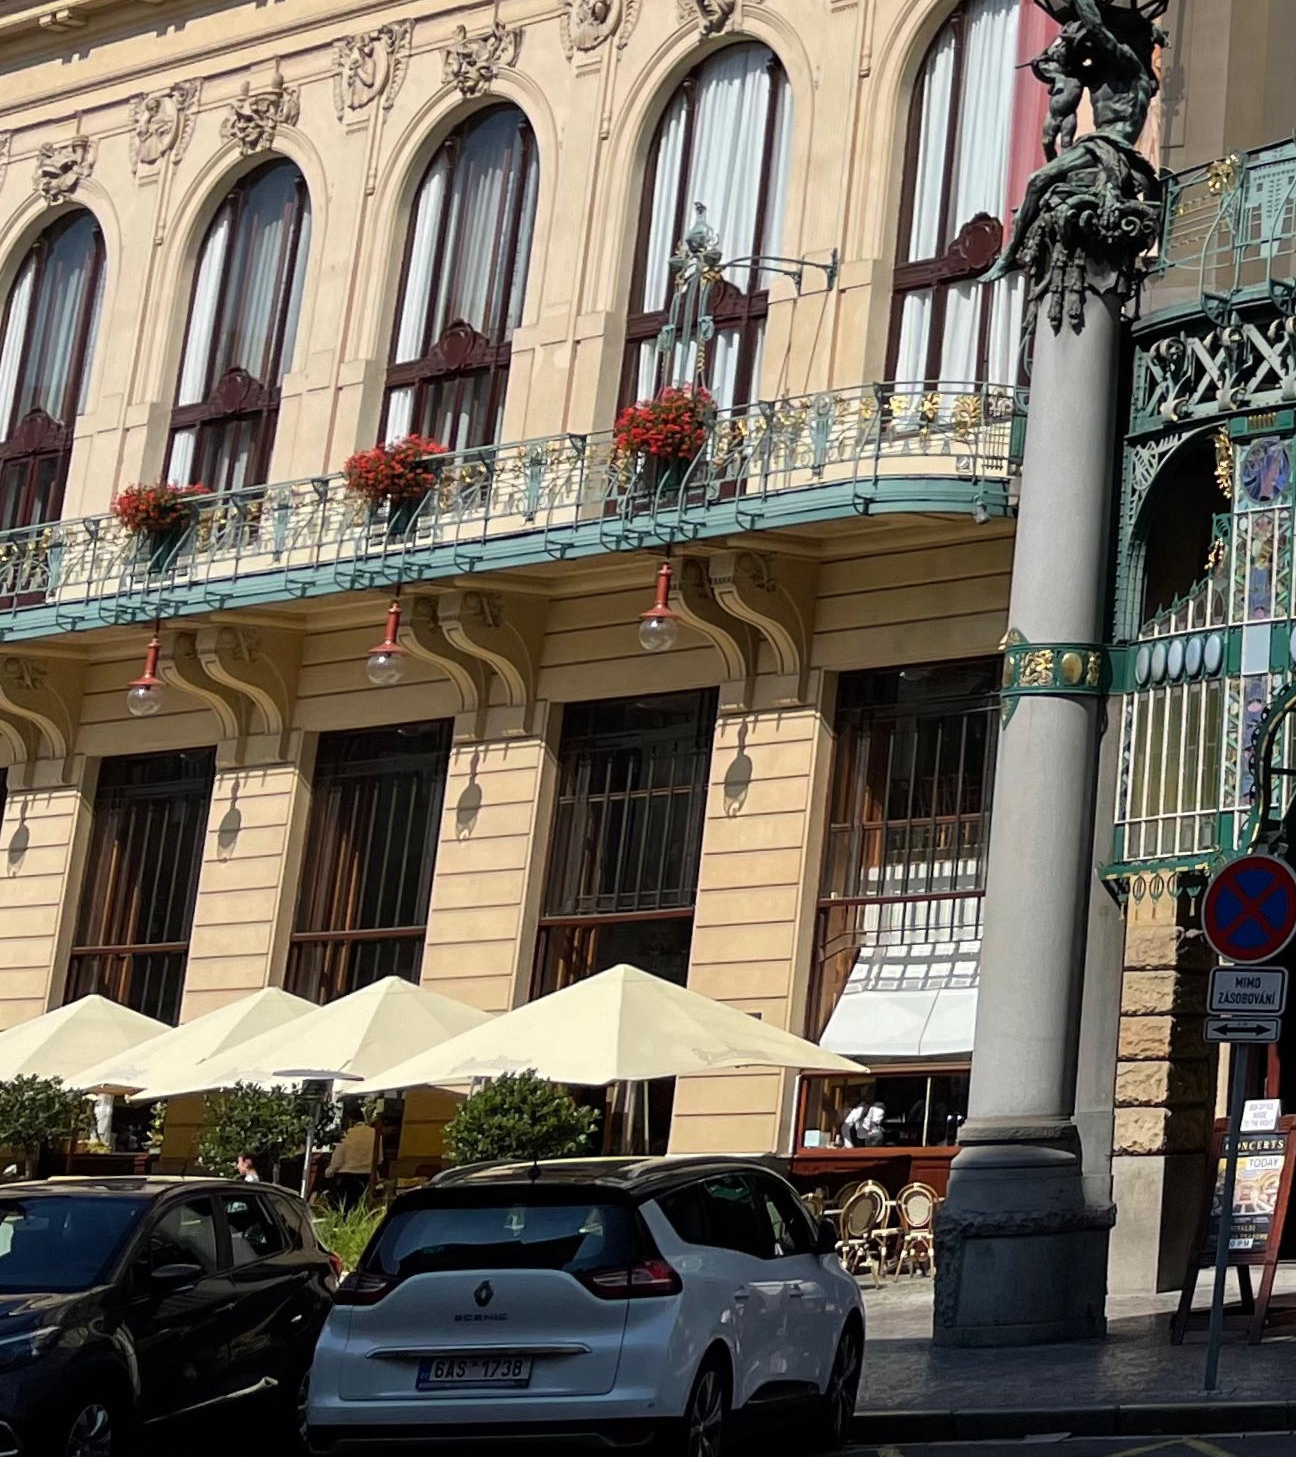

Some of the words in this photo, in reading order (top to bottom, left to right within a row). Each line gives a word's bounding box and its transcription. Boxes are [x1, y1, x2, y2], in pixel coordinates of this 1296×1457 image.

[1235, 977, 1261, 989] MIMO
[1218, 990, 1276, 1005] ZÁSOBOVÁNÍ
[1249, 1158, 1279, 1168] TODAY
[454, 1313, 508, 1322] SCENIC
[434, 1360, 466, 1378] 6AS
[480, 1359, 524, 1378] 1738
